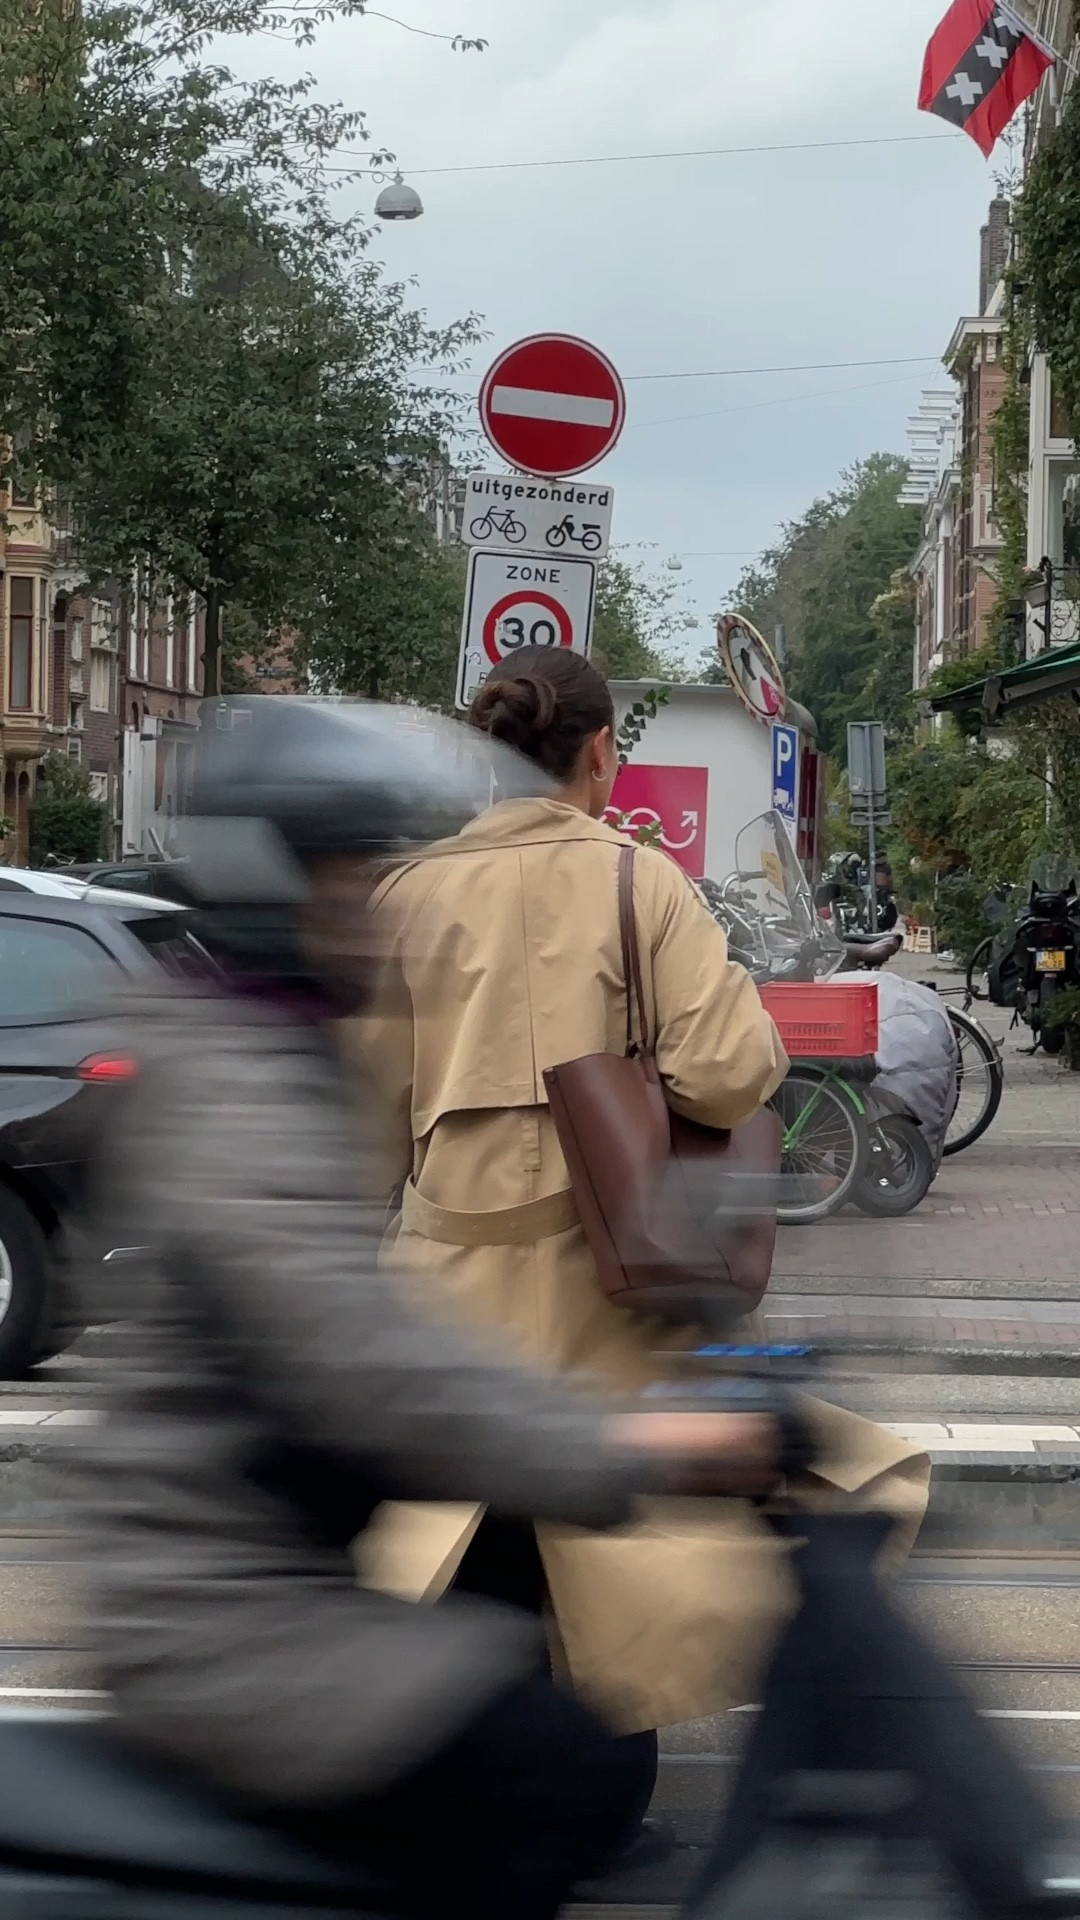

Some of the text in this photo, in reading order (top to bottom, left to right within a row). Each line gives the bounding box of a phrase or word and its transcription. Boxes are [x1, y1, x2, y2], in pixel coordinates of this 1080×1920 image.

[472, 478, 610, 506] uitgezonderd
[506, 565, 561, 583] ZONE
[500, 617, 556, 649] 30
[777, 731, 792, 776] P
